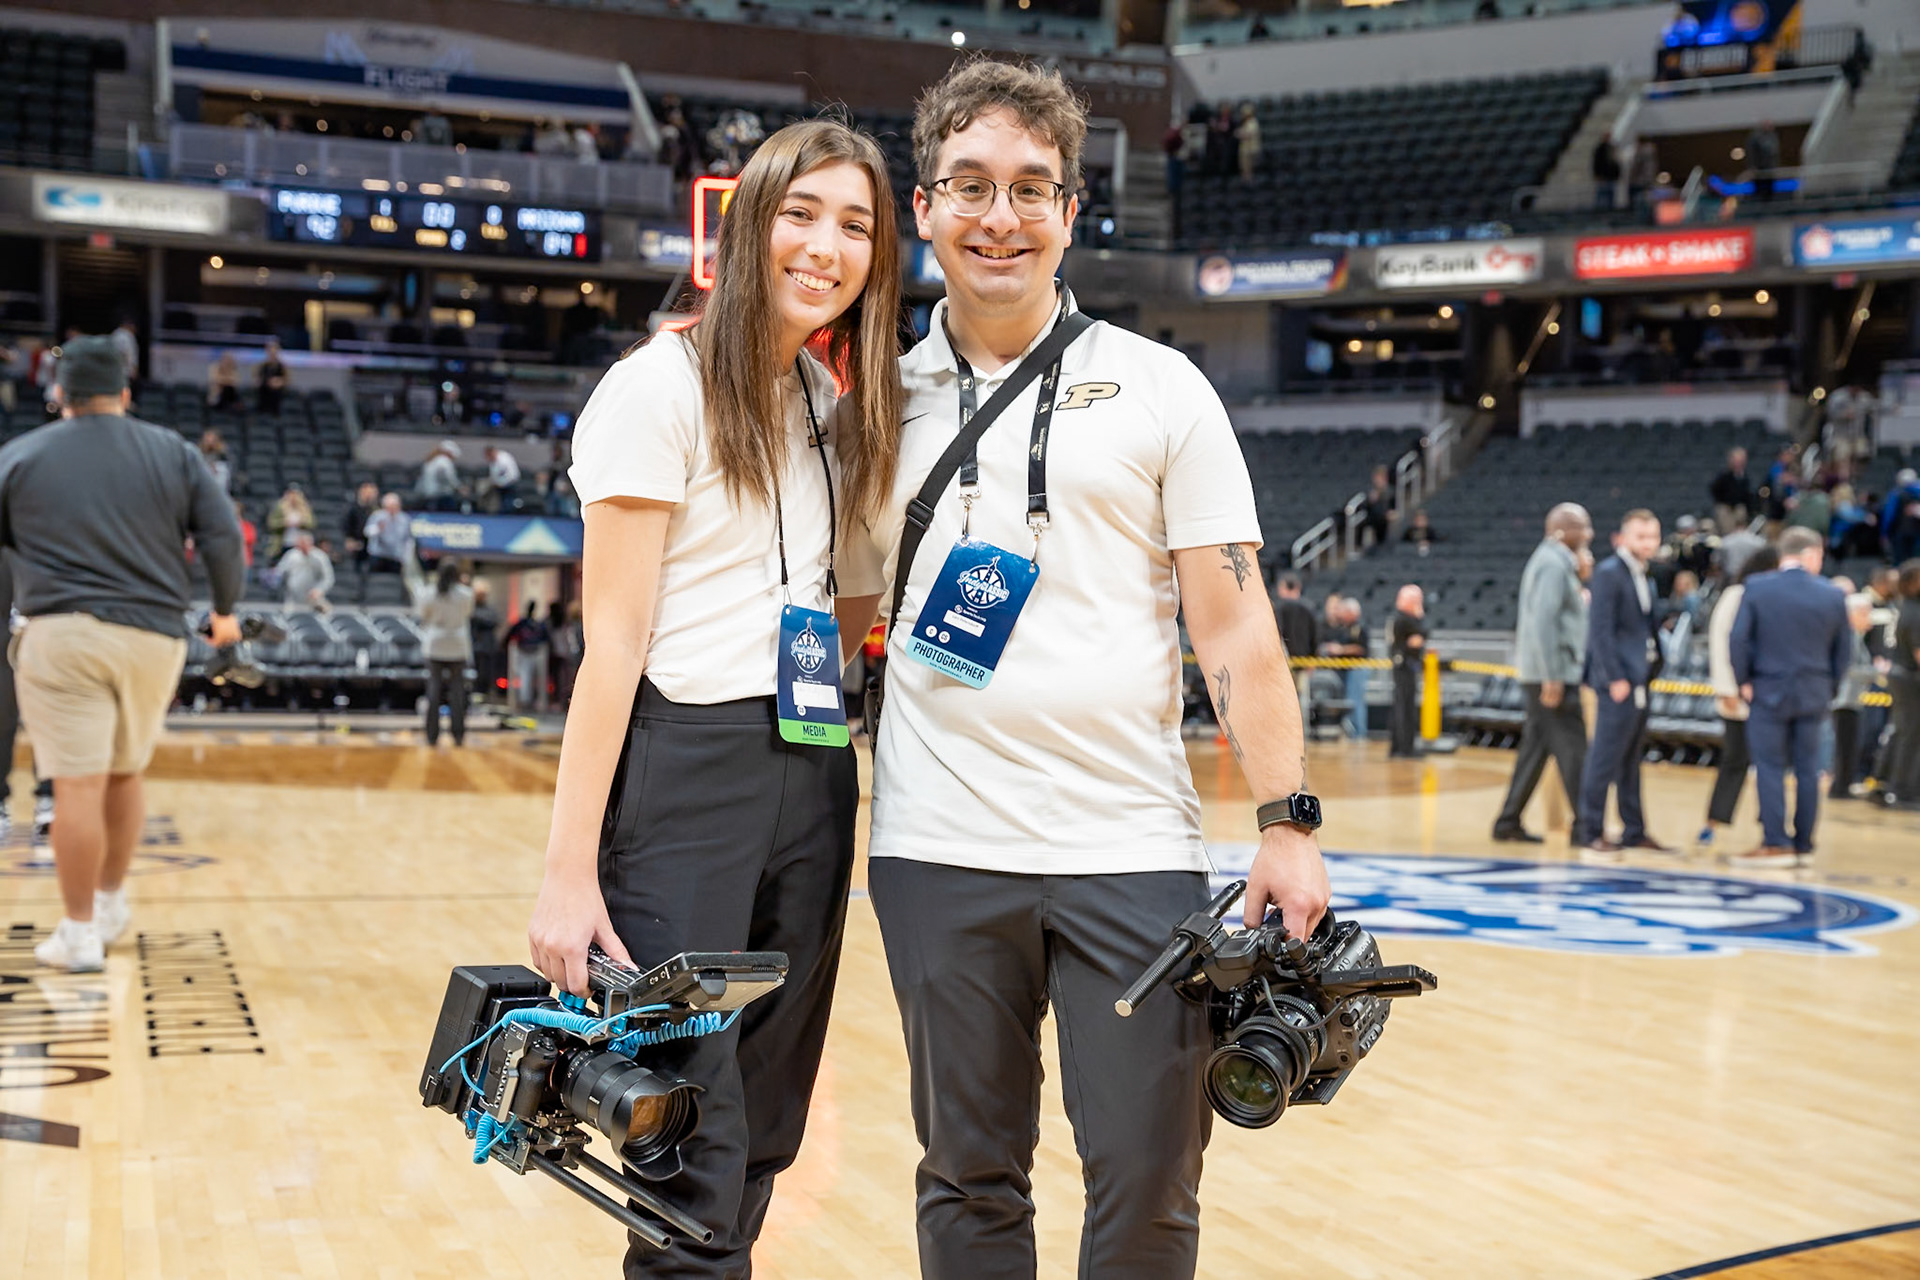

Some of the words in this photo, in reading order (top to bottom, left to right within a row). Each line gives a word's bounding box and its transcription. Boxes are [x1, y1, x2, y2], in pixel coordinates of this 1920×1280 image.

[1378, 252, 1479, 281] KeyBank
[1578, 243, 1650, 270] STEAK
[1667, 236, 1746, 266] SHAKE
[1055, 382, 1121, 411] P
[913, 642, 985, 682] PHOTOGRAPHER
[802, 725, 827, 737] MEDIA
